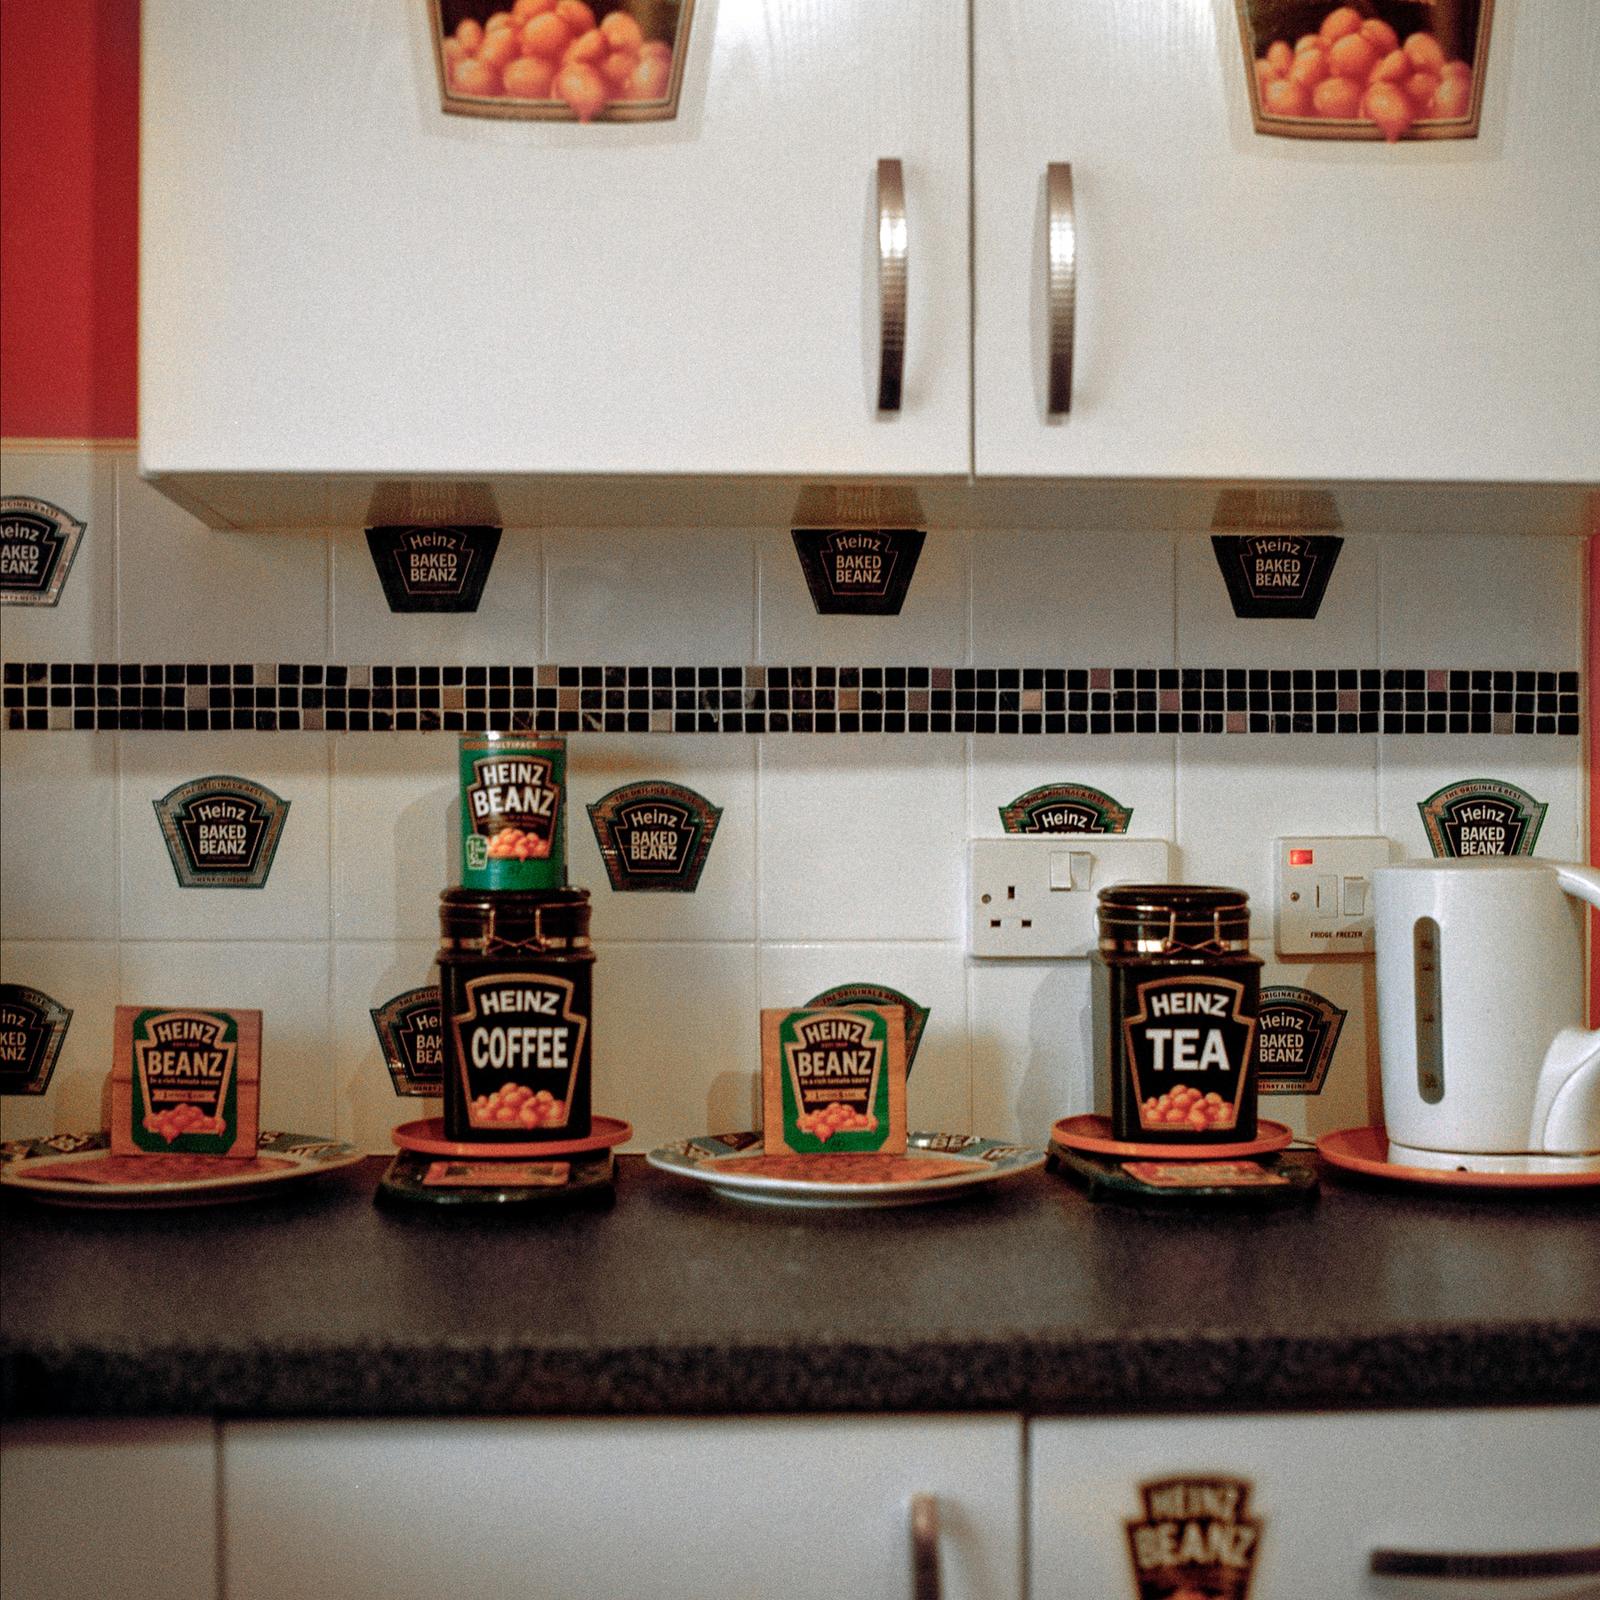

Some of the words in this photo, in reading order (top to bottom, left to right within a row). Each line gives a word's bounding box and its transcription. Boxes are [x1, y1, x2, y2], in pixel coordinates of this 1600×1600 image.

[410, 532, 457, 550] Heinz
[836, 534, 881, 551] Heinz
[1255, 538, 1300, 555] Heinz
[1, 544, 39, 560] AKED
[1, 560, 39, 575] EANZ
[410, 553, 457, 568] BAKED
[836, 555, 882, 569] BAKED
[1255, 559, 1301, 572] BAKED
[410, 568, 457, 582] BEANZ
[836, 569, 881, 583] BEANZ
[1255, 573, 1300, 587] BEANZ
[482, 762, 544, 786] HEINZ
[473, 785, 555, 817] BEANZ
[199, 802, 247, 821] Heinz
[631, 809, 678, 828] Heinz
[1042, 809, 1088, 828] Heinz
[1461, 805, 1505, 823] Heinz
[199, 824, 247, 839] BAKED
[631, 831, 678, 845] BAKED
[1461, 827, 1505, 840] BAKED
[199, 840, 246, 855] BEANZ
[631, 845, 677, 860] BEANZ
[1461, 842, 1505, 855] BEANZ
[480, 989, 560, 1016] HEINZ
[1151, 992, 1230, 1018] HEINZ
[1, 1009, 26, 1027] inz
[1260, 1012, 1304, 1030] Heinz
[1, 1032, 27, 1046] KED
[157, 1021, 216, 1044] HEINZ
[805, 1021, 863, 1044] HEINZ
[416, 1035, 443, 1049] BAK
[471, 1026, 569, 1069] COFFEE
[1260, 1034, 1304, 1048] BAKED
[1, 1046, 26, 1060] ANZ
[416, 1050, 443, 1064] BEA
[1145, 1028, 1231, 1071] TEA
[1260, 1048, 1303, 1063] BEANZ
[148, 1050, 223, 1077] BEANZ
[798, 1051, 872, 1077] BEANZ
[1134, 1522, 1255, 1568] BEANZ
